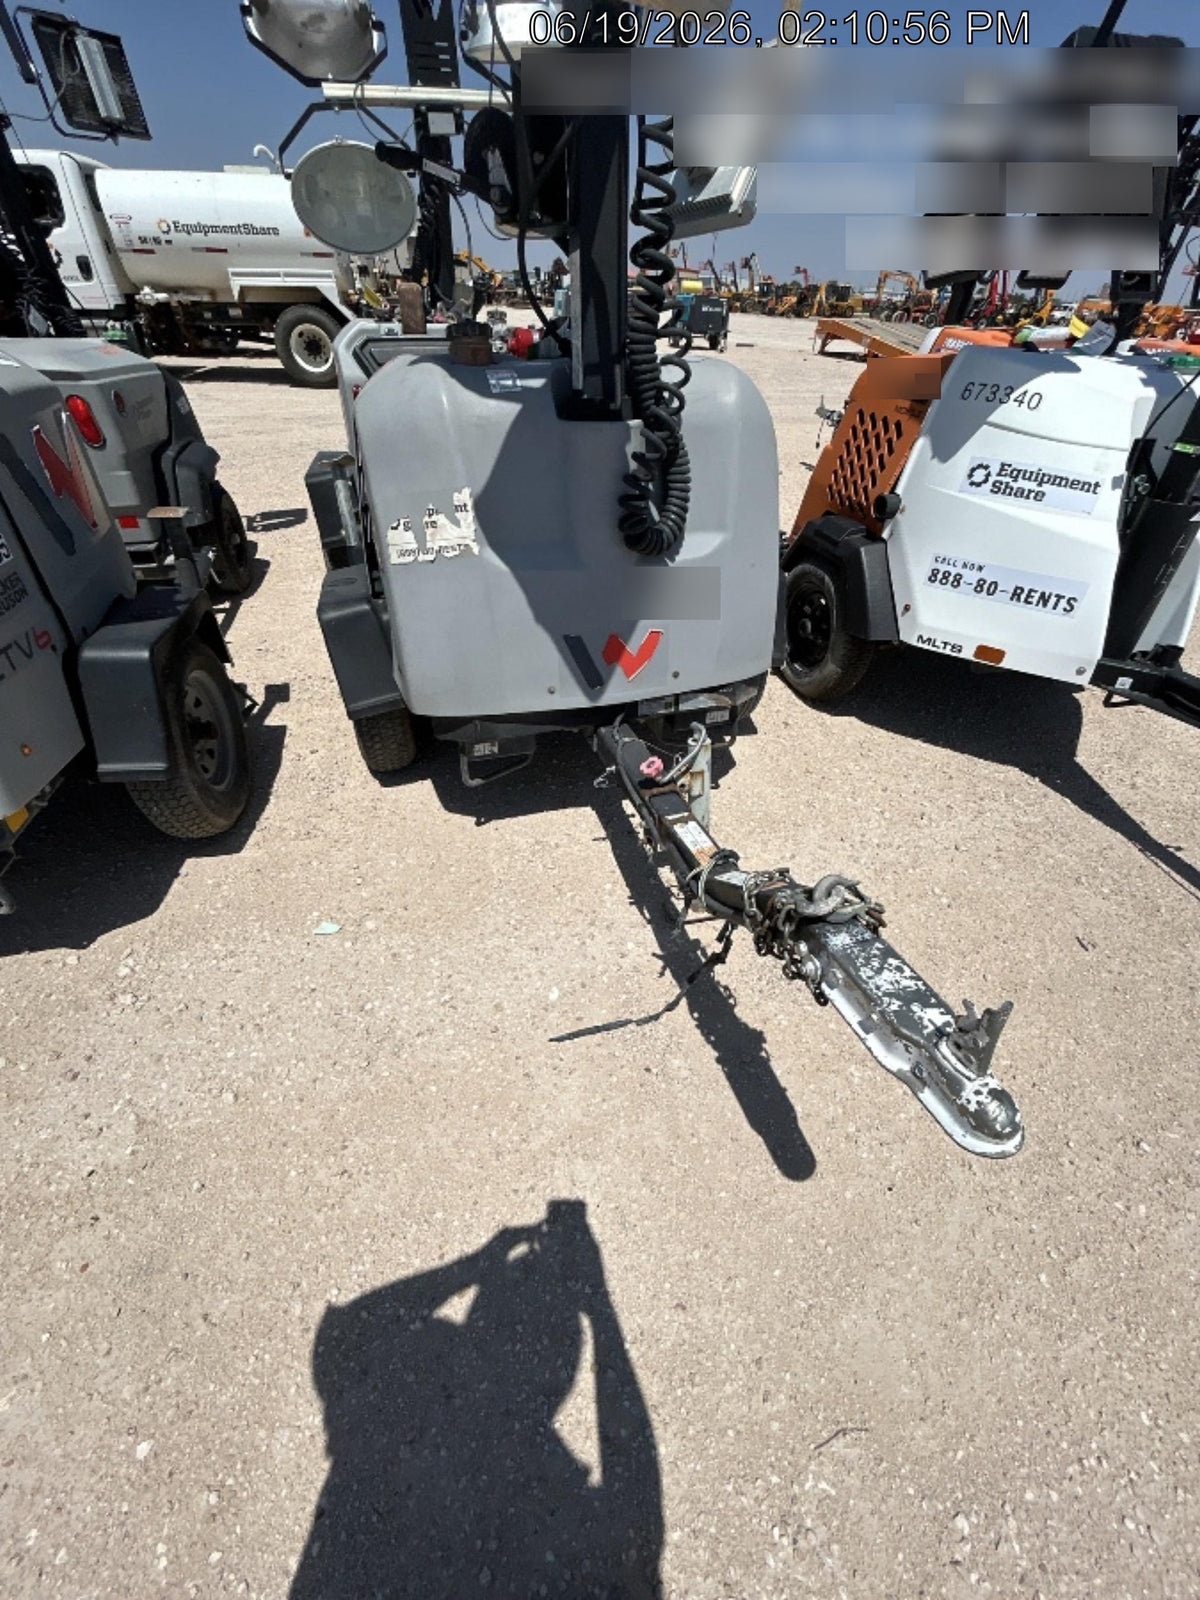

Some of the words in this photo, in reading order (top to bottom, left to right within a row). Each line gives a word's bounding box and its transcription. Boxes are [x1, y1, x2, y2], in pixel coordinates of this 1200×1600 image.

[172, 220, 280, 236] EquipmentShare
[961, 381, 1043, 411] 673340
[990, 480, 1046, 502] Share
[996, 462, 1102, 495] Equipment
[928, 568, 1079, 614] 888-80-RENTS
